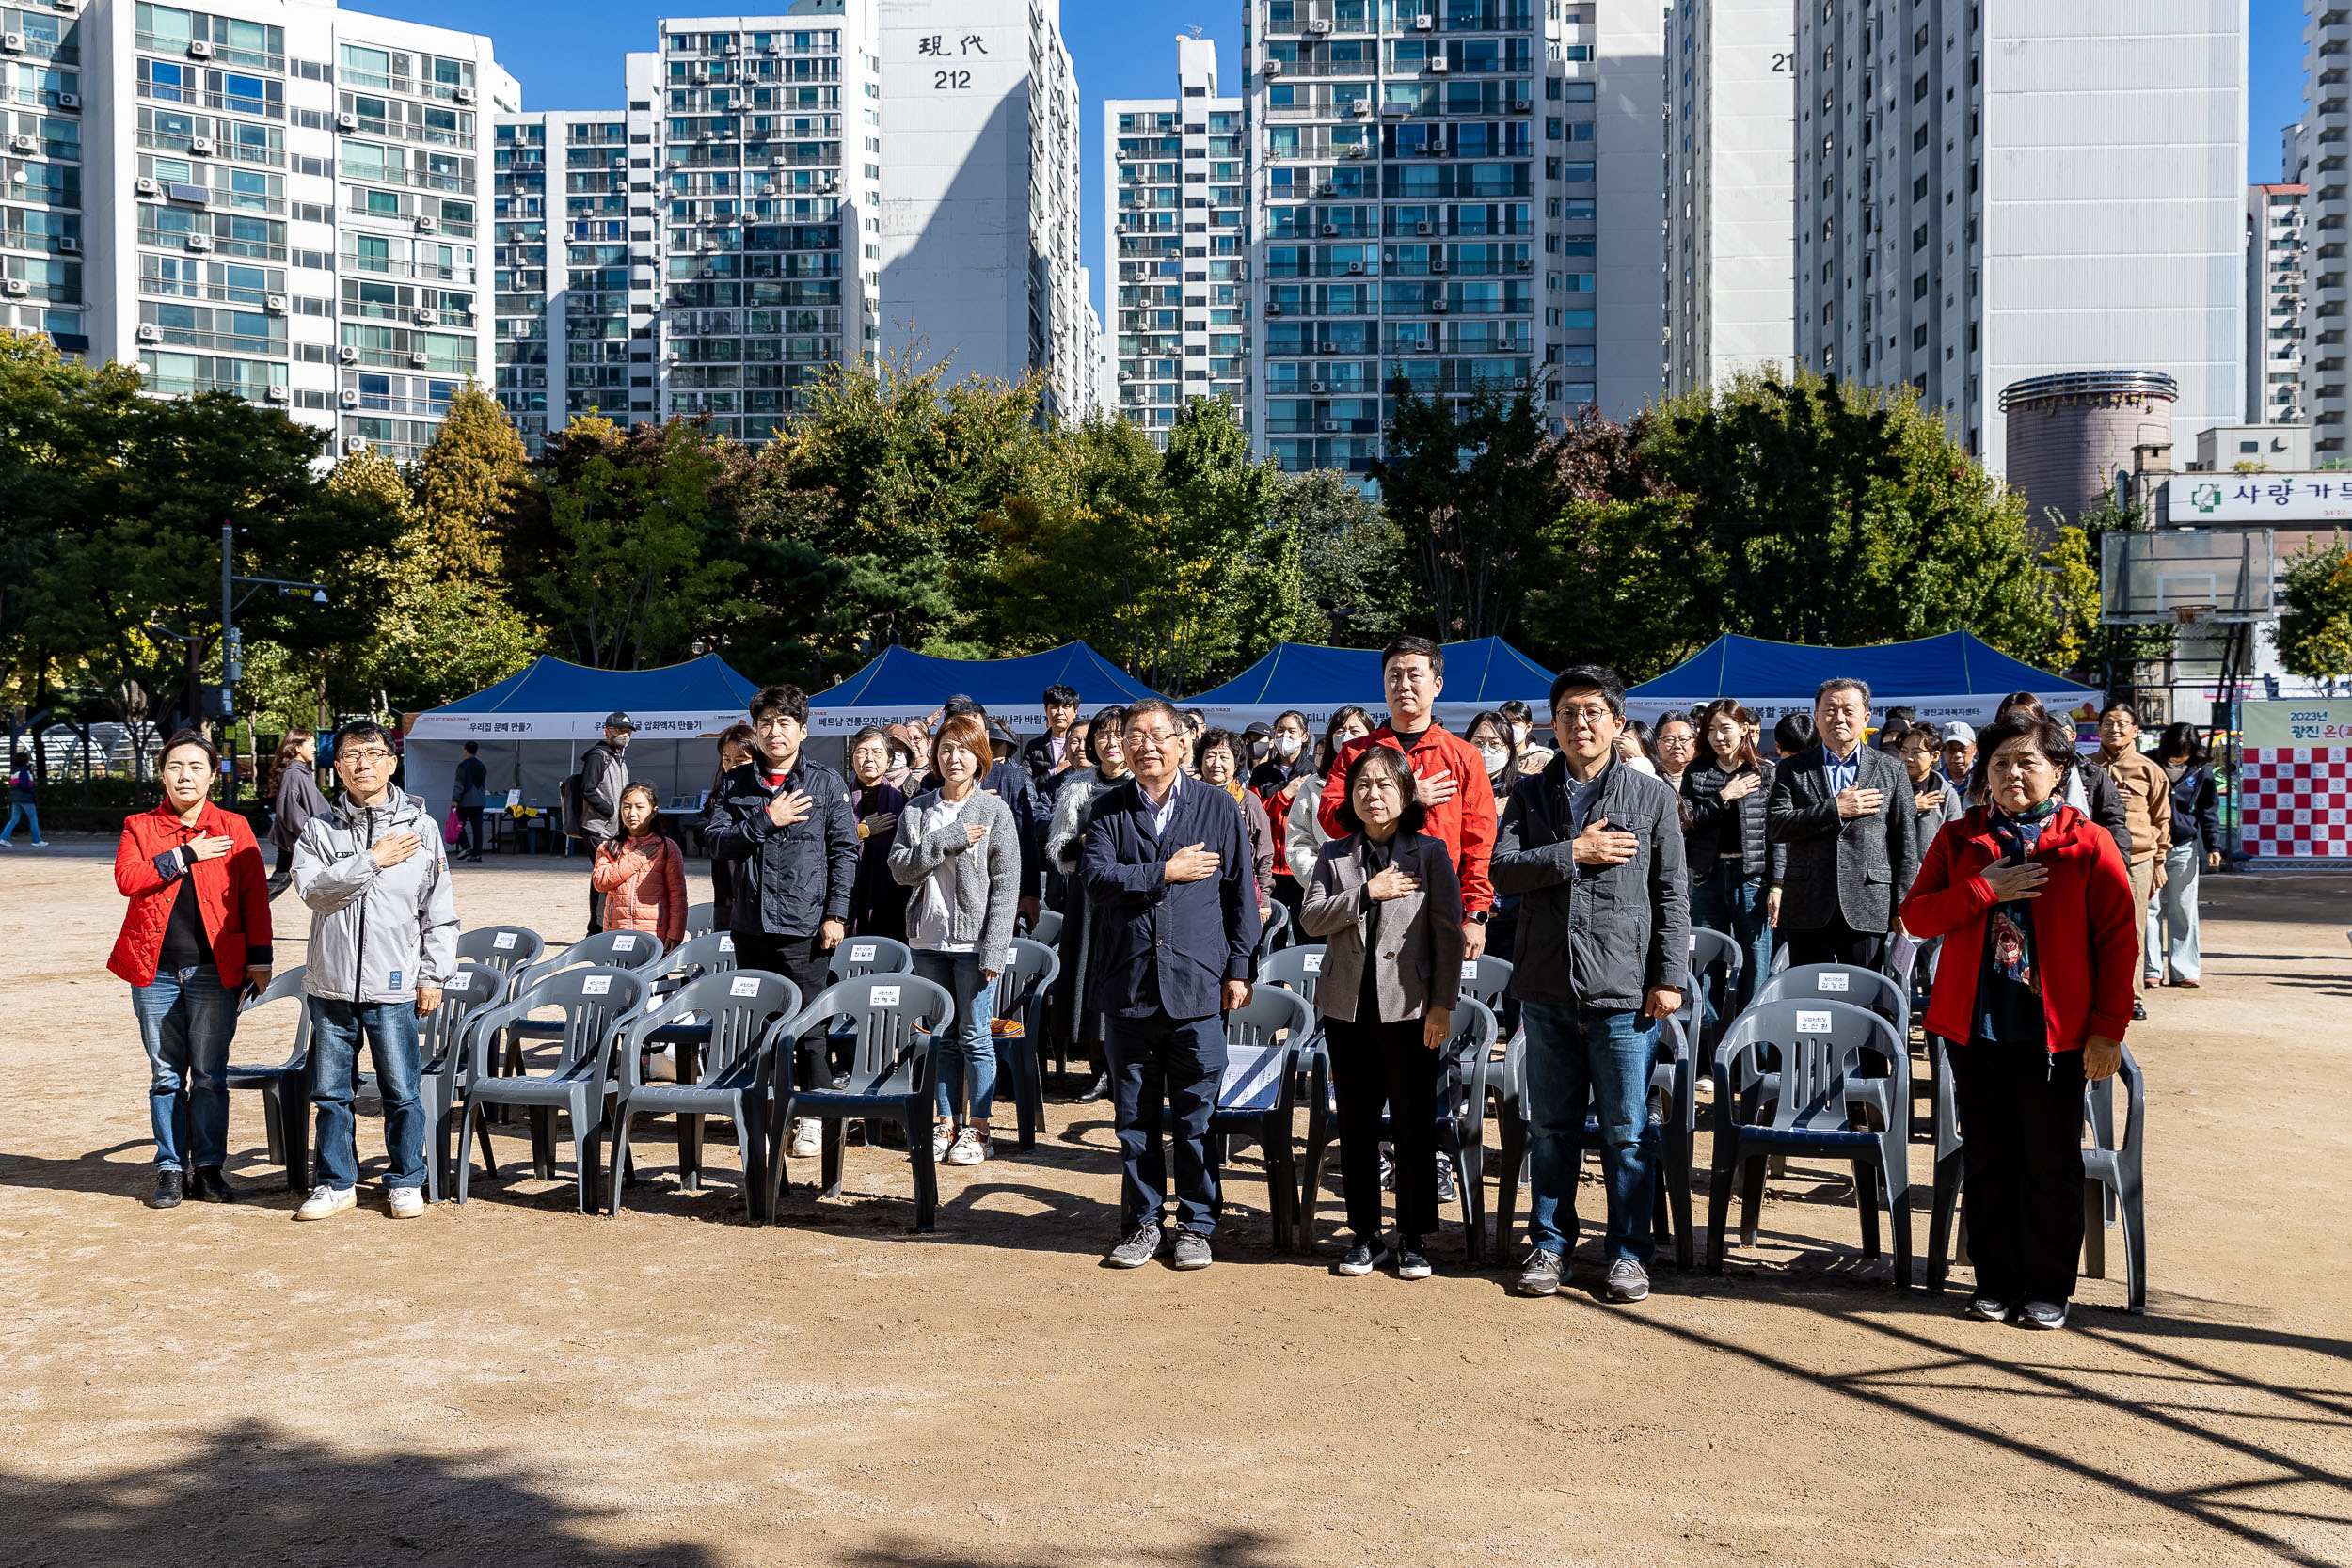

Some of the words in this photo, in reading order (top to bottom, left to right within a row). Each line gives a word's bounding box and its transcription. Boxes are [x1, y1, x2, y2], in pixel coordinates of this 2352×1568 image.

[934, 71, 971, 89] 212
[2233, 483, 2294, 506] 사랑
[819, 717, 844, 727] 베트남
[2290, 711, 2328, 721] 2023년
[469, 721, 491, 733] 우리집
[511, 721, 533, 732] 만들기
[644, 721, 676, 731] 압화액자
[678, 720, 702, 731] 만들기
[2291, 725, 2319, 739] 광진
